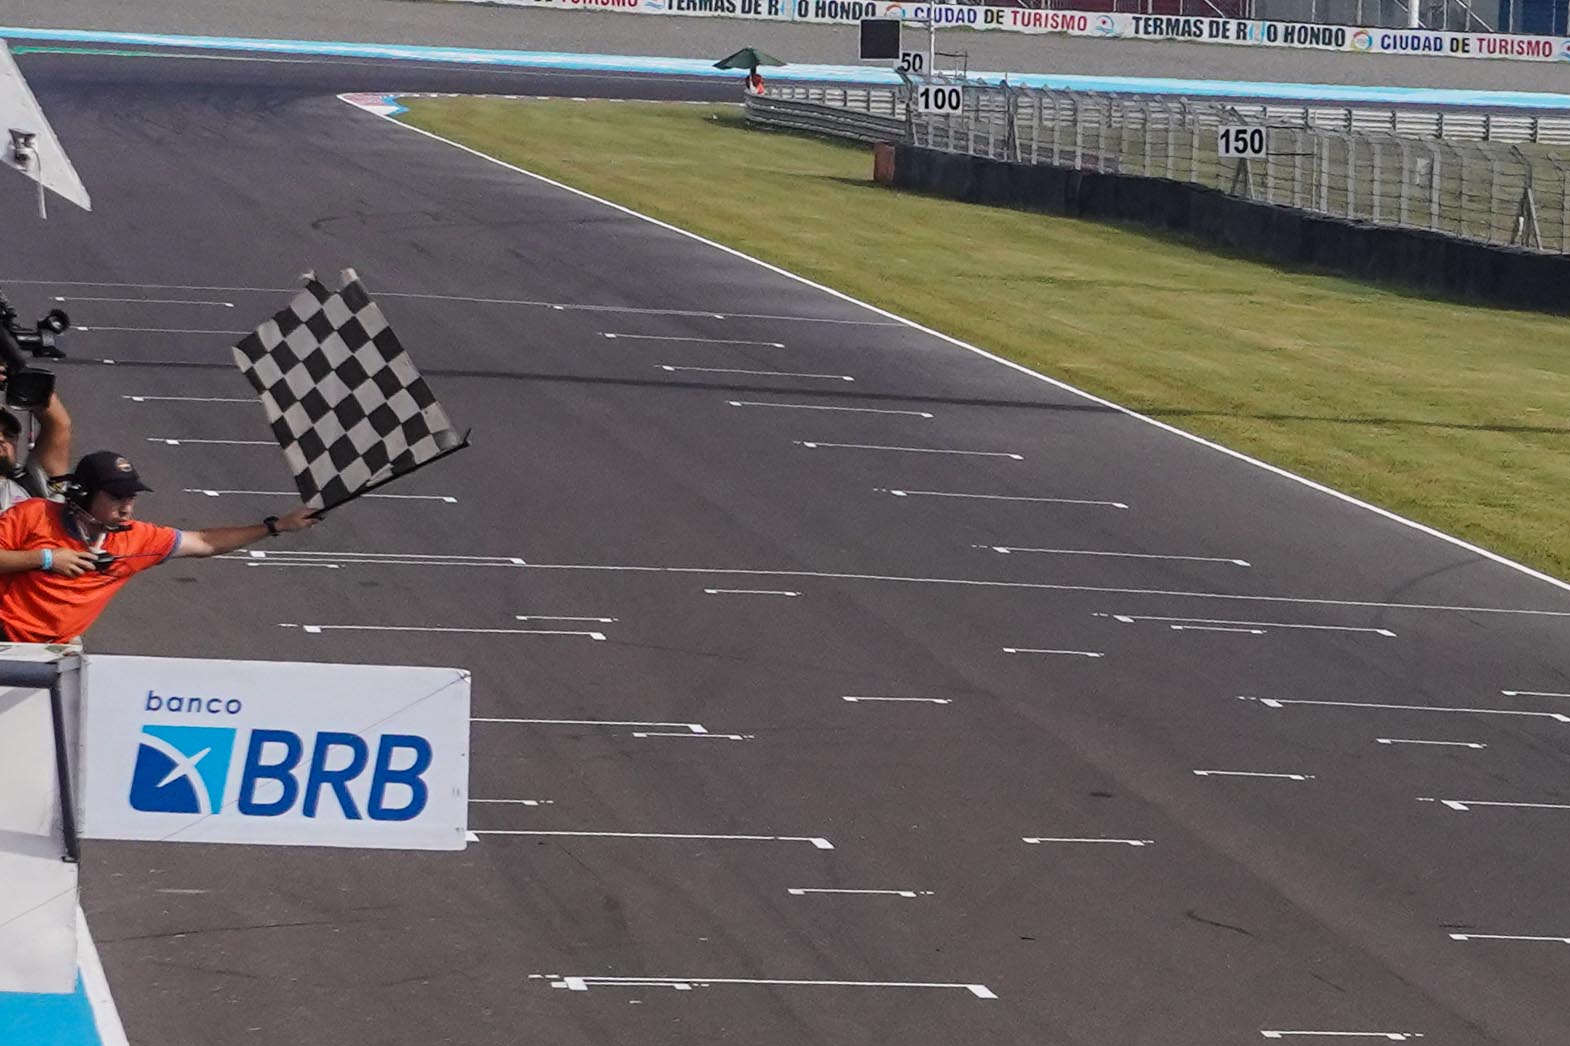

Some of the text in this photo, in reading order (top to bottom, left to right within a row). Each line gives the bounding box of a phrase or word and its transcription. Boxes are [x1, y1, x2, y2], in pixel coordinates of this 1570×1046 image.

[815, 0, 877, 20] HONDO
[914, 7, 1087, 31] CIUDAD DE TURISMO
[1132, 16, 1204, 38] TERMAS
[1208, 20, 1230, 40] DE
[1283, 24, 1346, 48] HONDO
[1381, 33, 1552, 58] CIUDAD DE TURISMO
[900, 52, 923, 73] 50
[919, 87, 961, 111] 100
[1220, 128, 1264, 154] 150
[144, 690, 242, 716] banco
[238, 728, 433, 822] BRB
